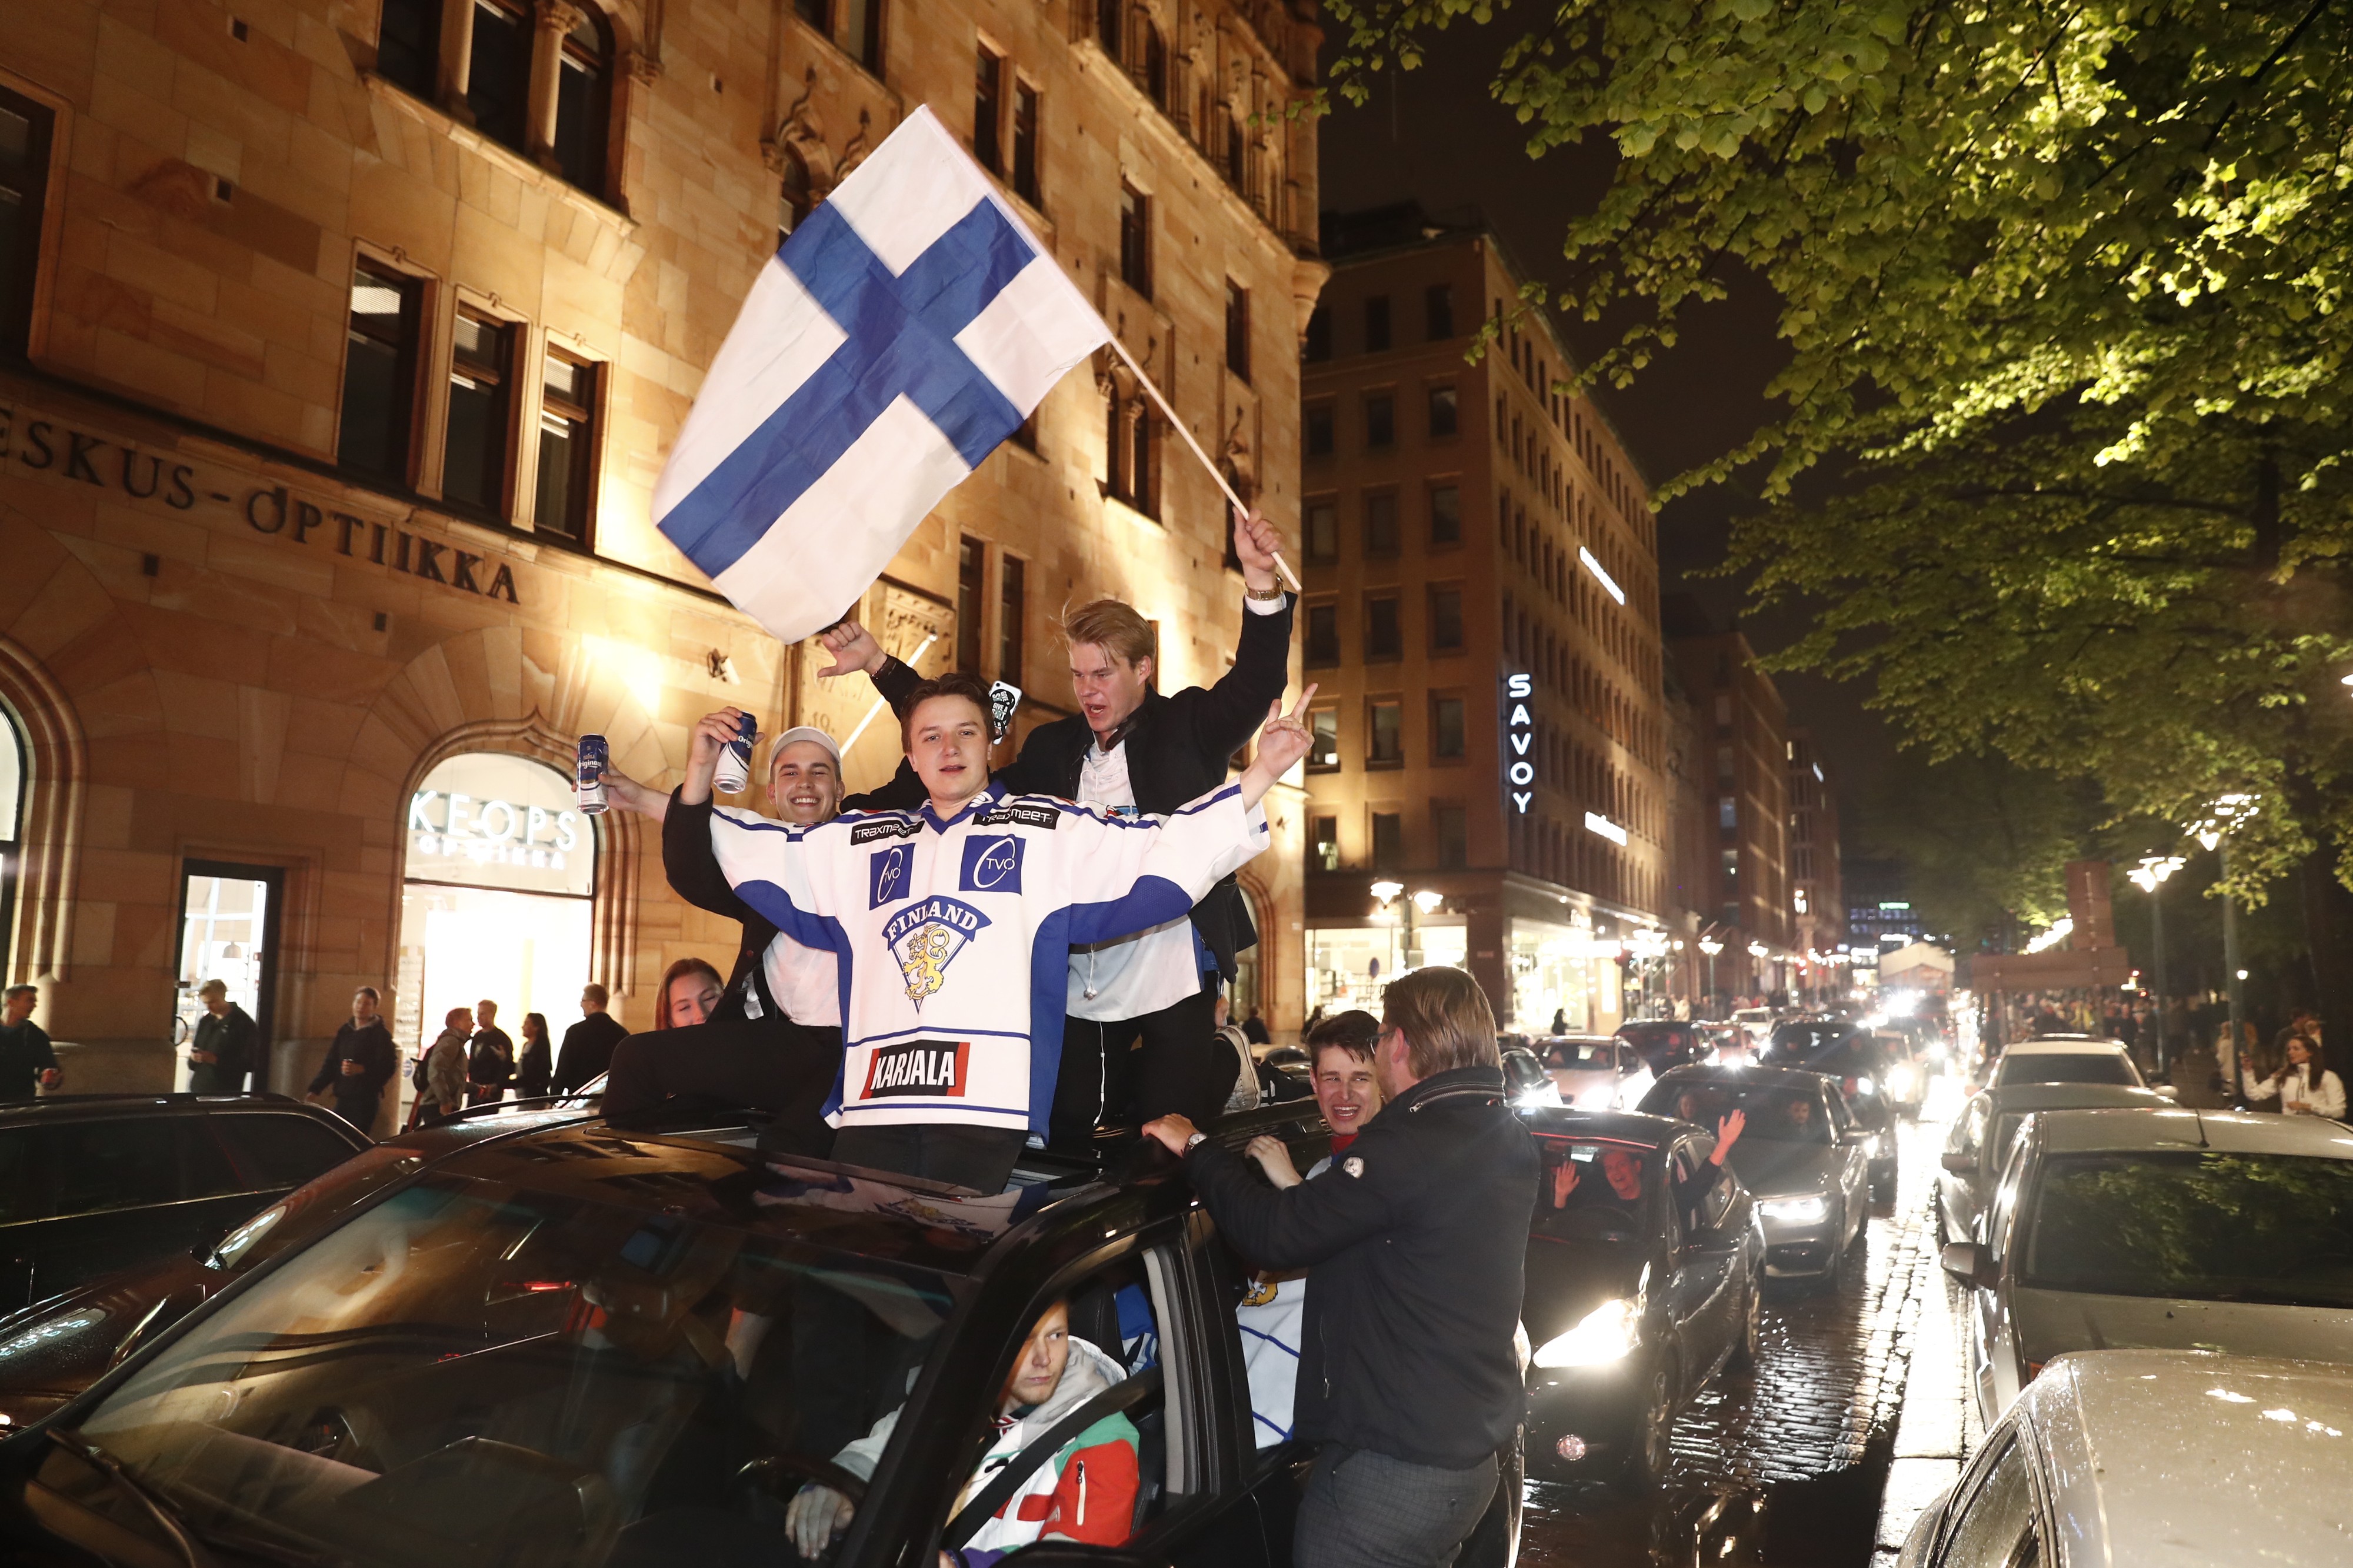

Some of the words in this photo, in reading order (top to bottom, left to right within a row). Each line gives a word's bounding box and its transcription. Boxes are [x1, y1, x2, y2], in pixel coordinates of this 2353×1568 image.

[992, 702, 1004, 711] GIVE
[1508, 673, 1534, 814] SAVOY
[408, 790, 576, 852] KEOPS
[986, 858, 1015, 870] TVO
[887, 900, 978, 942] FINLAND
[870, 1048, 955, 1090] KARJALA
